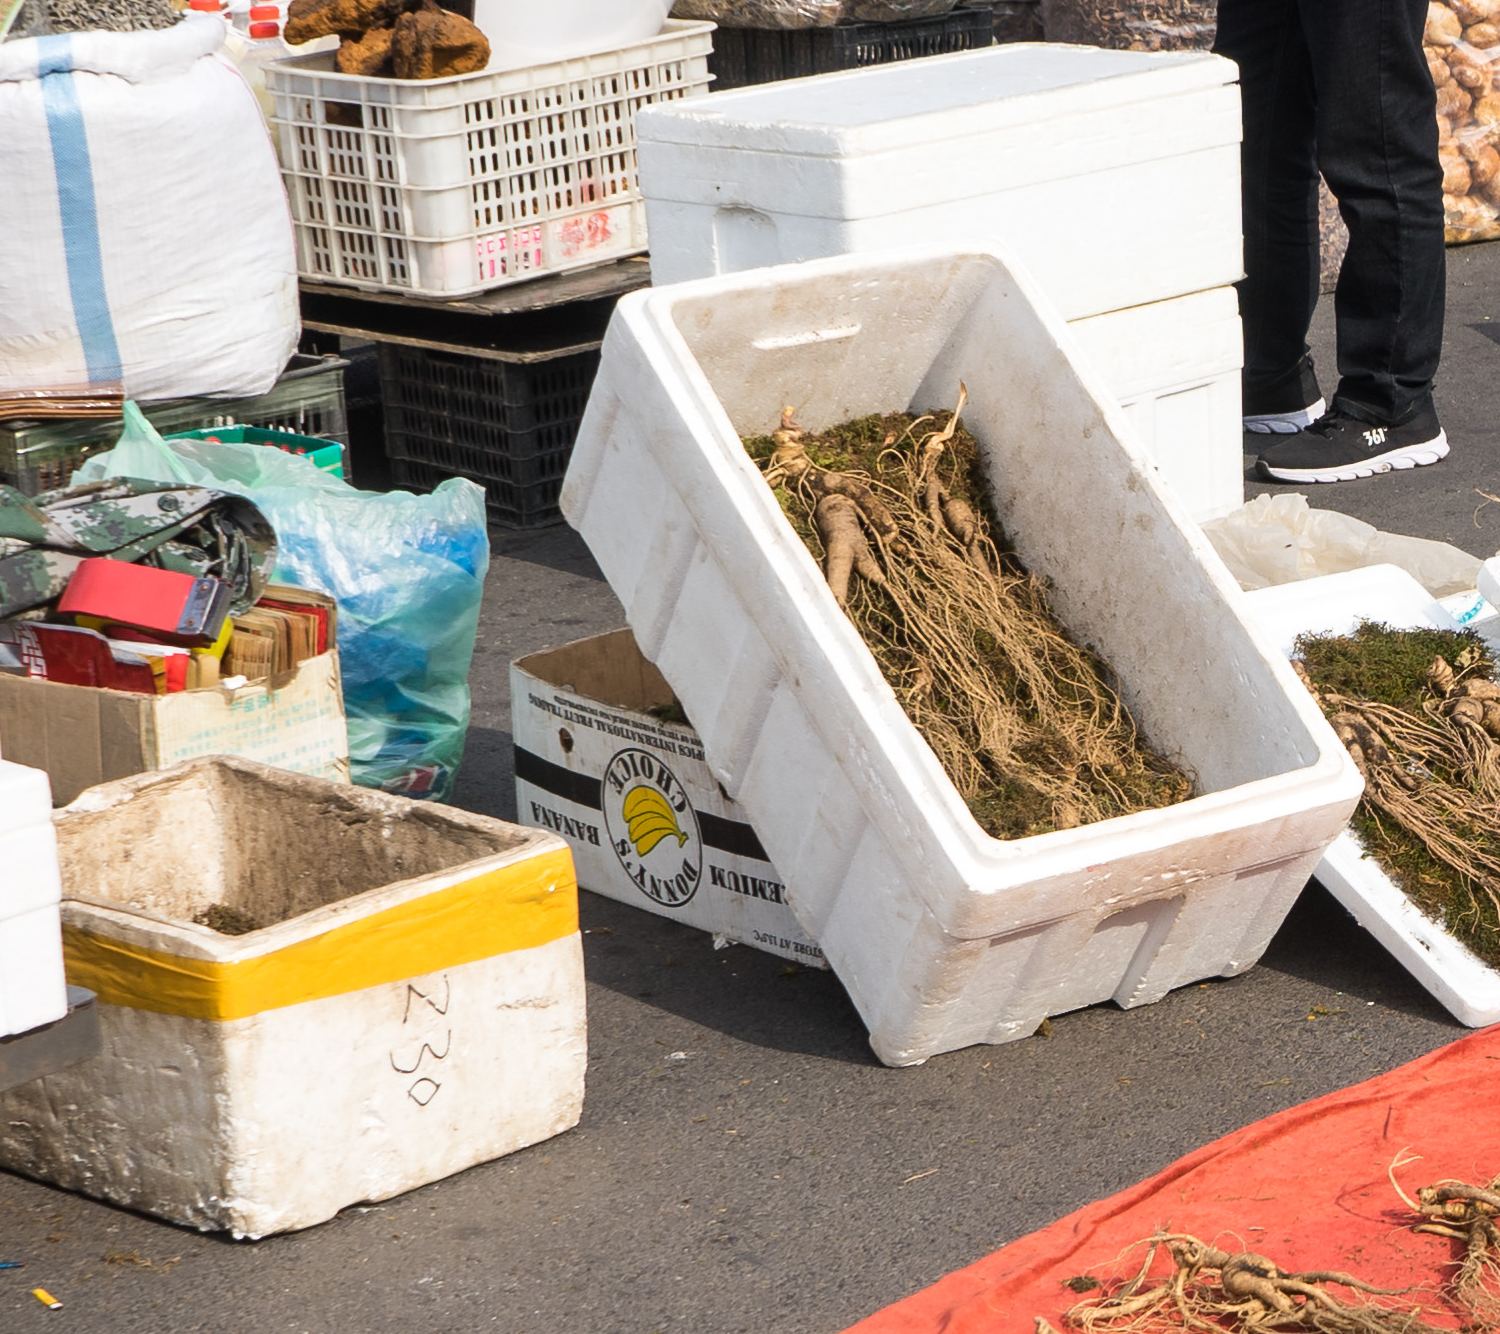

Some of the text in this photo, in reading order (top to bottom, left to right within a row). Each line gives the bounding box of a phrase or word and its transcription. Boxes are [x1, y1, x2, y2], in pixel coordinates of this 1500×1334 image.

[528, 692, 564, 717] TRADING
[596, 717, 677, 753] INTERNATIONAL
[607, 752, 688, 814] CHOICE
[530, 801, 788, 905] EMIUM BANANA
[614, 837, 700, 903] DONNY'S
